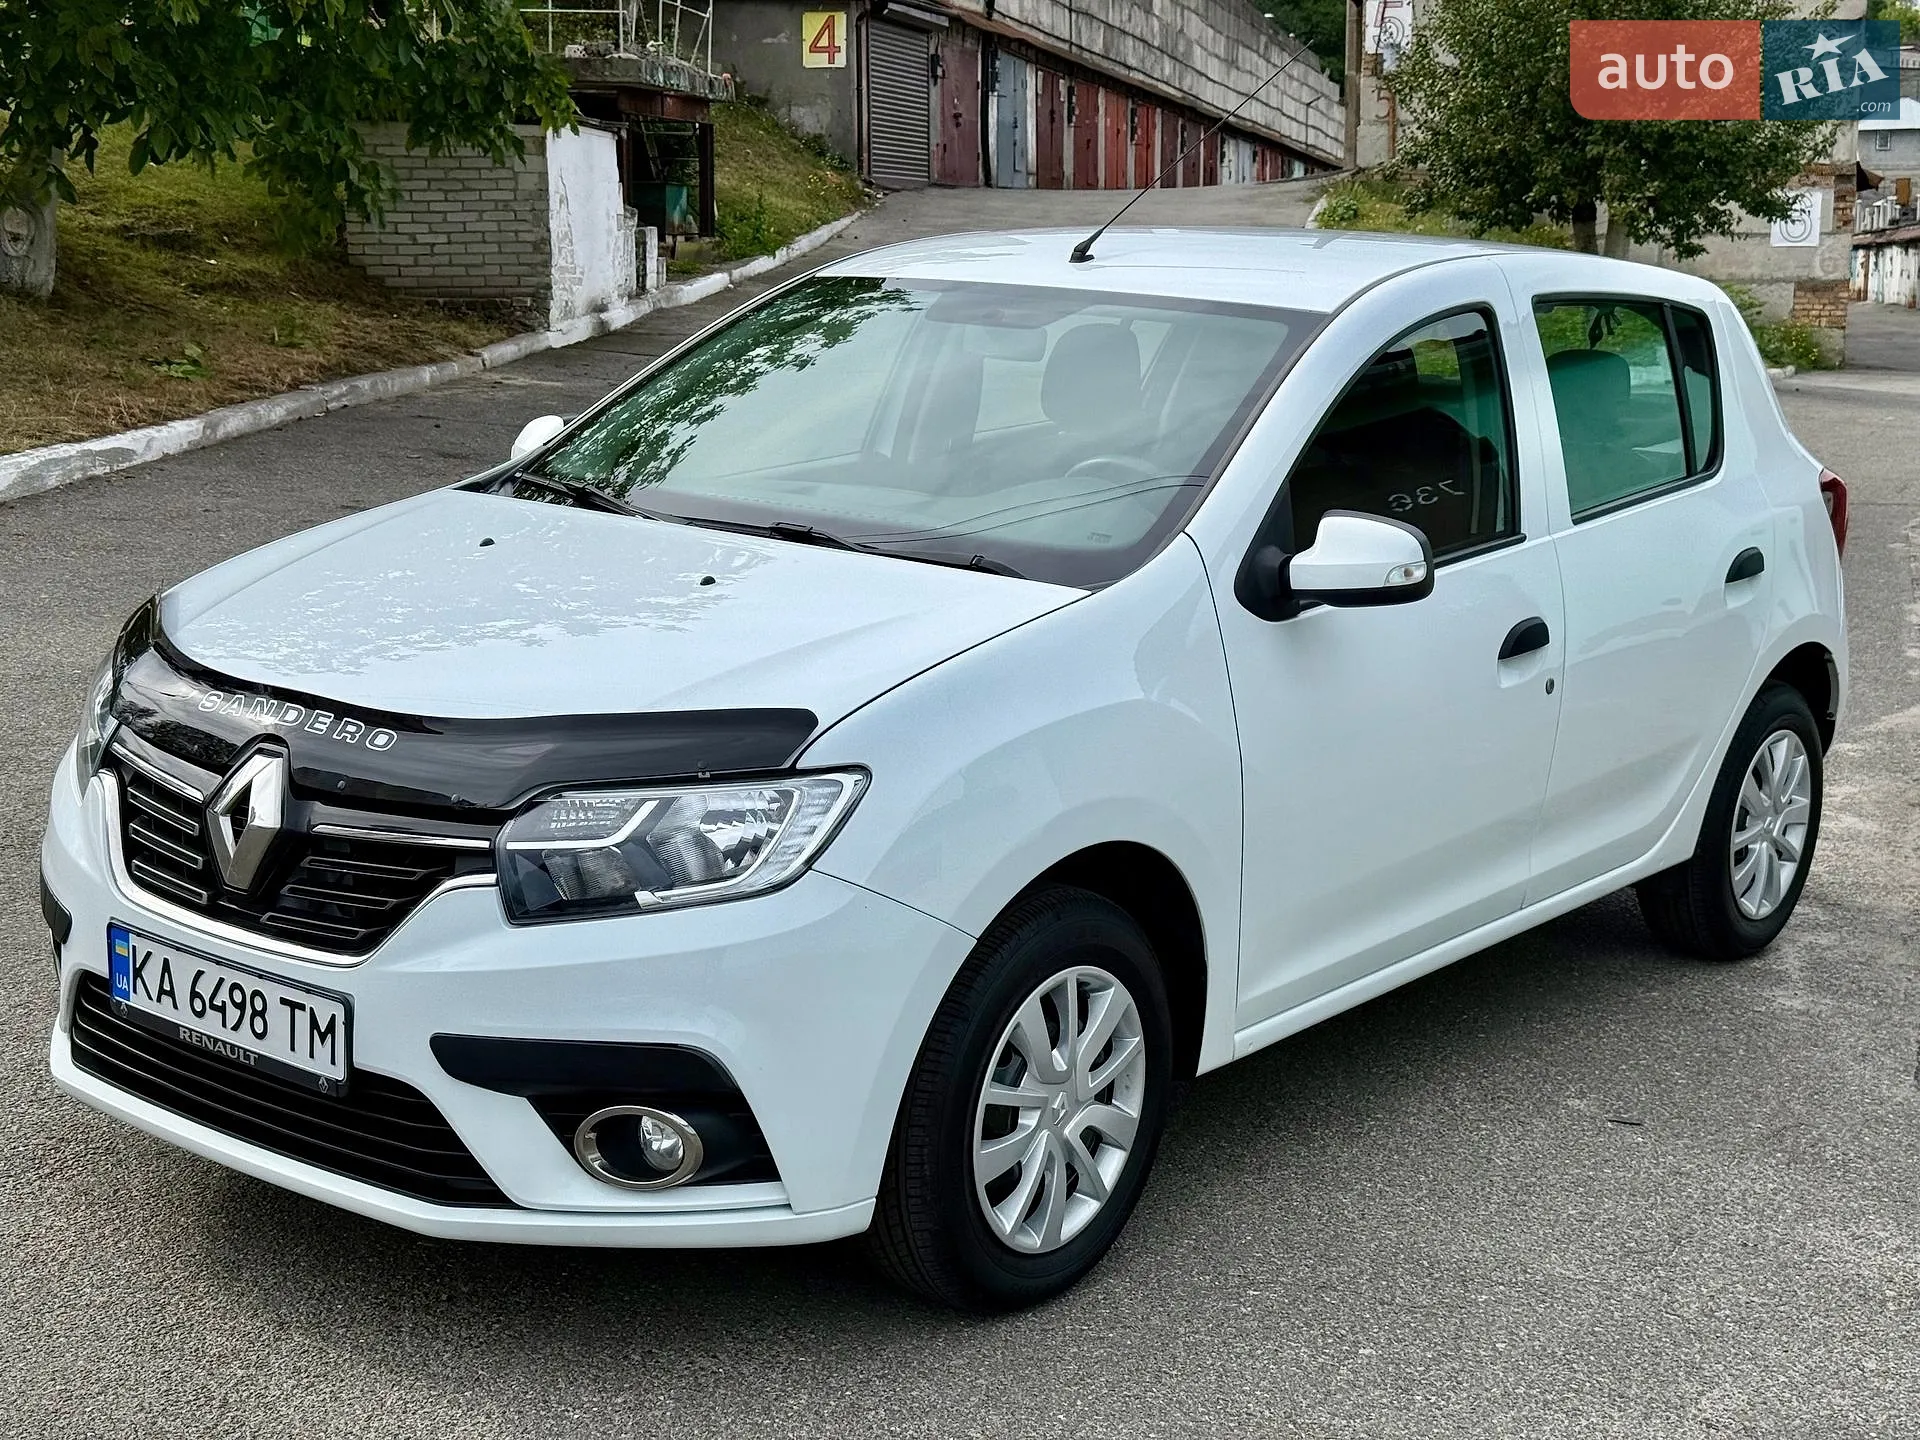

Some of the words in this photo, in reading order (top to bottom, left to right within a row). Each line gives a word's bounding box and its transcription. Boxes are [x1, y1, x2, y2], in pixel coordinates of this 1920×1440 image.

[808, 14, 841, 65] 4
[1373, 0, 1405, 49] 5
[198, 690, 398, 751] SANDERO
[116, 972, 129, 991] UA
[132, 944, 179, 1010] KA
[189, 969, 268, 1040] 6498
[279, 996, 337, 1066] TM
[178, 1026, 259, 1066] RENAULT
